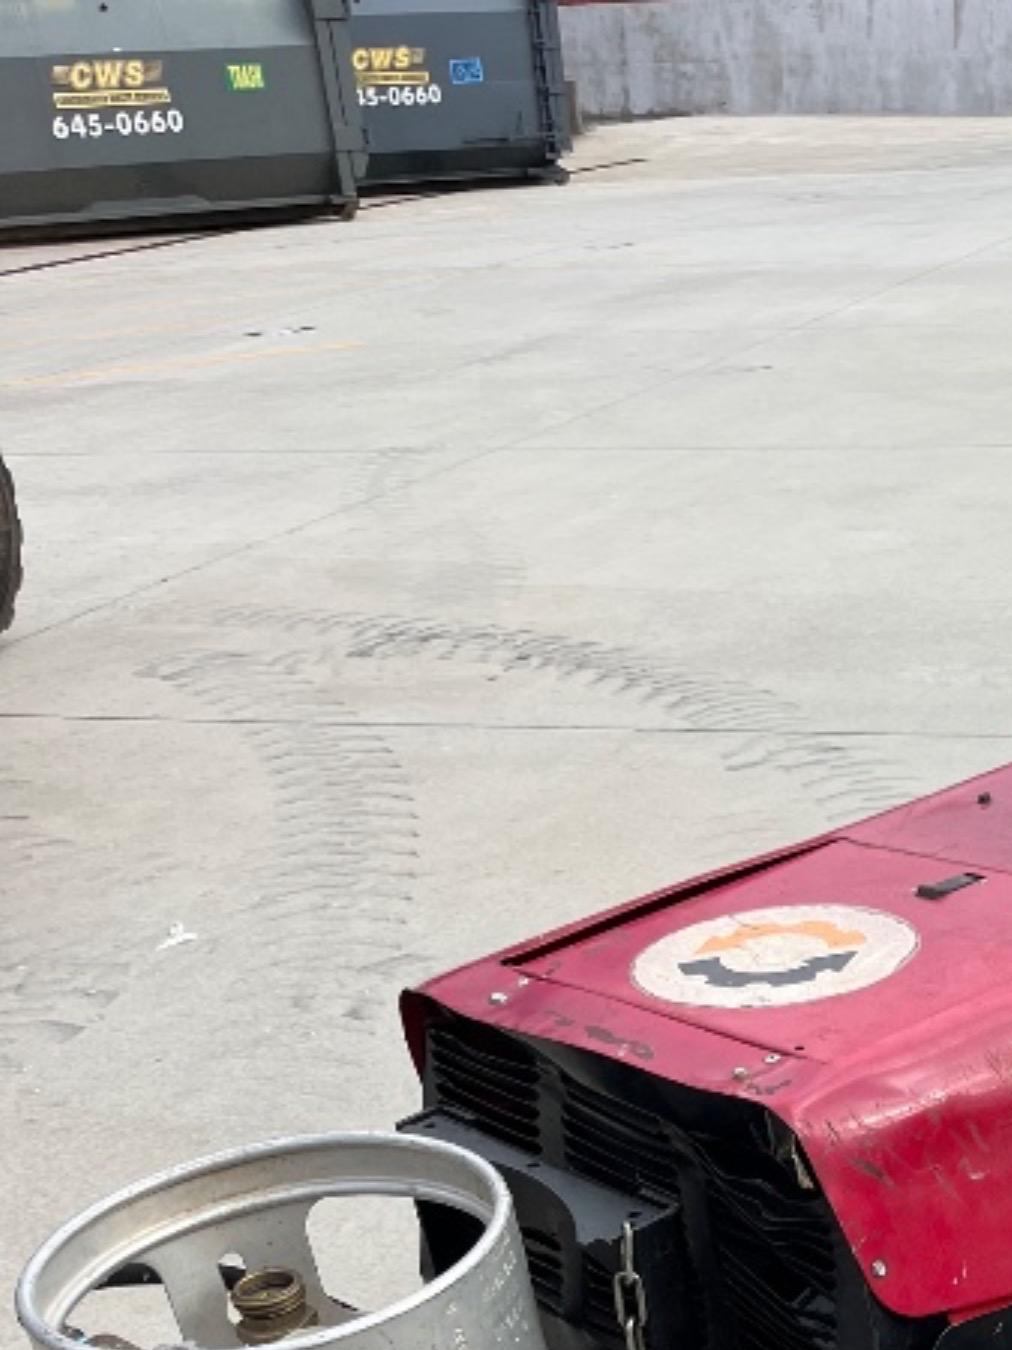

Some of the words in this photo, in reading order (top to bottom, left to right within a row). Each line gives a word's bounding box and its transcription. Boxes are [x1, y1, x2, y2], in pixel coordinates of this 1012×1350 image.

[352, 44, 411, 70] CWS
[70, 60, 145, 90] CWS
[53, 109, 183, 139] 645-0660
